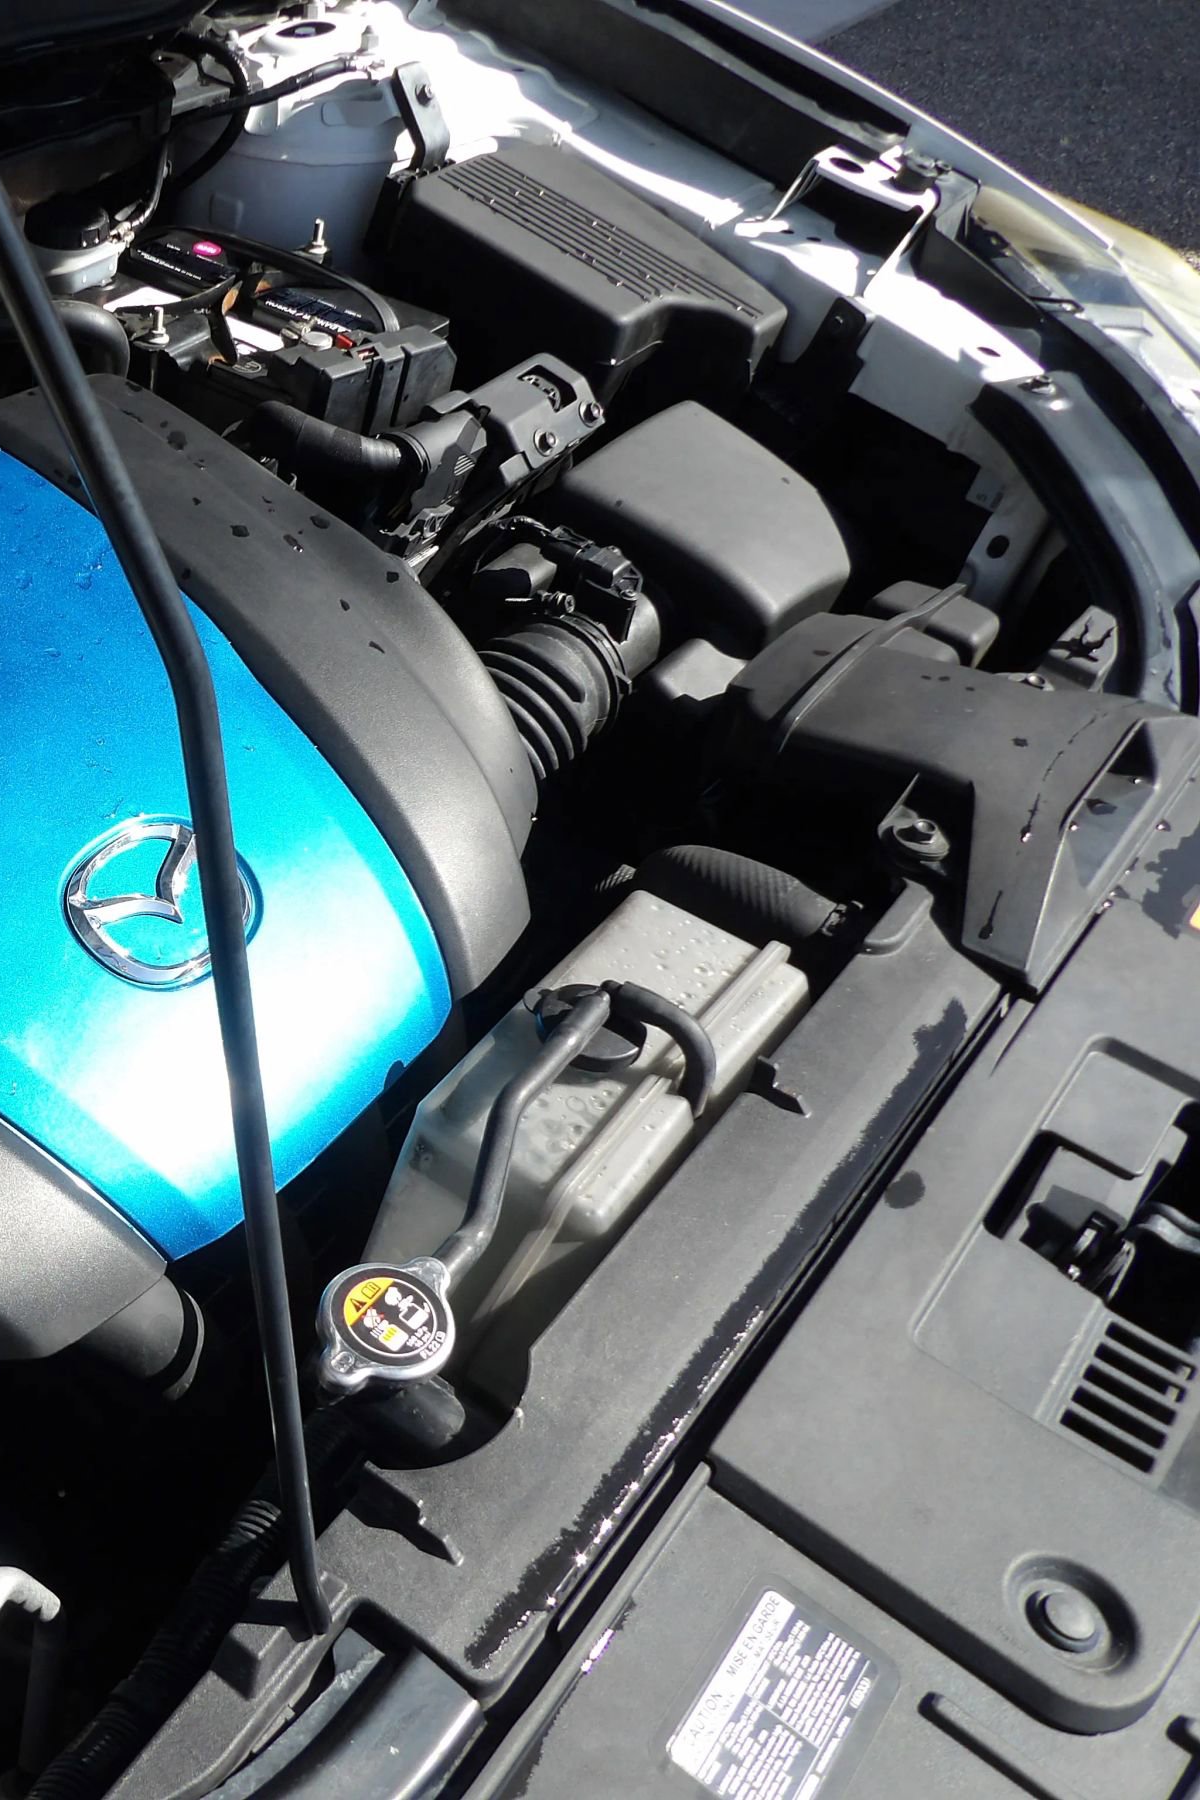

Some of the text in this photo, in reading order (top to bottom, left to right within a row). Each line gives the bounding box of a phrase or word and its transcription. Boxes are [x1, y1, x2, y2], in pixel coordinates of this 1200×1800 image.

[726, 1654, 747, 1678] MISE
[742, 1635, 758, 1651] EN
[752, 1596, 781, 1634] GARDE
